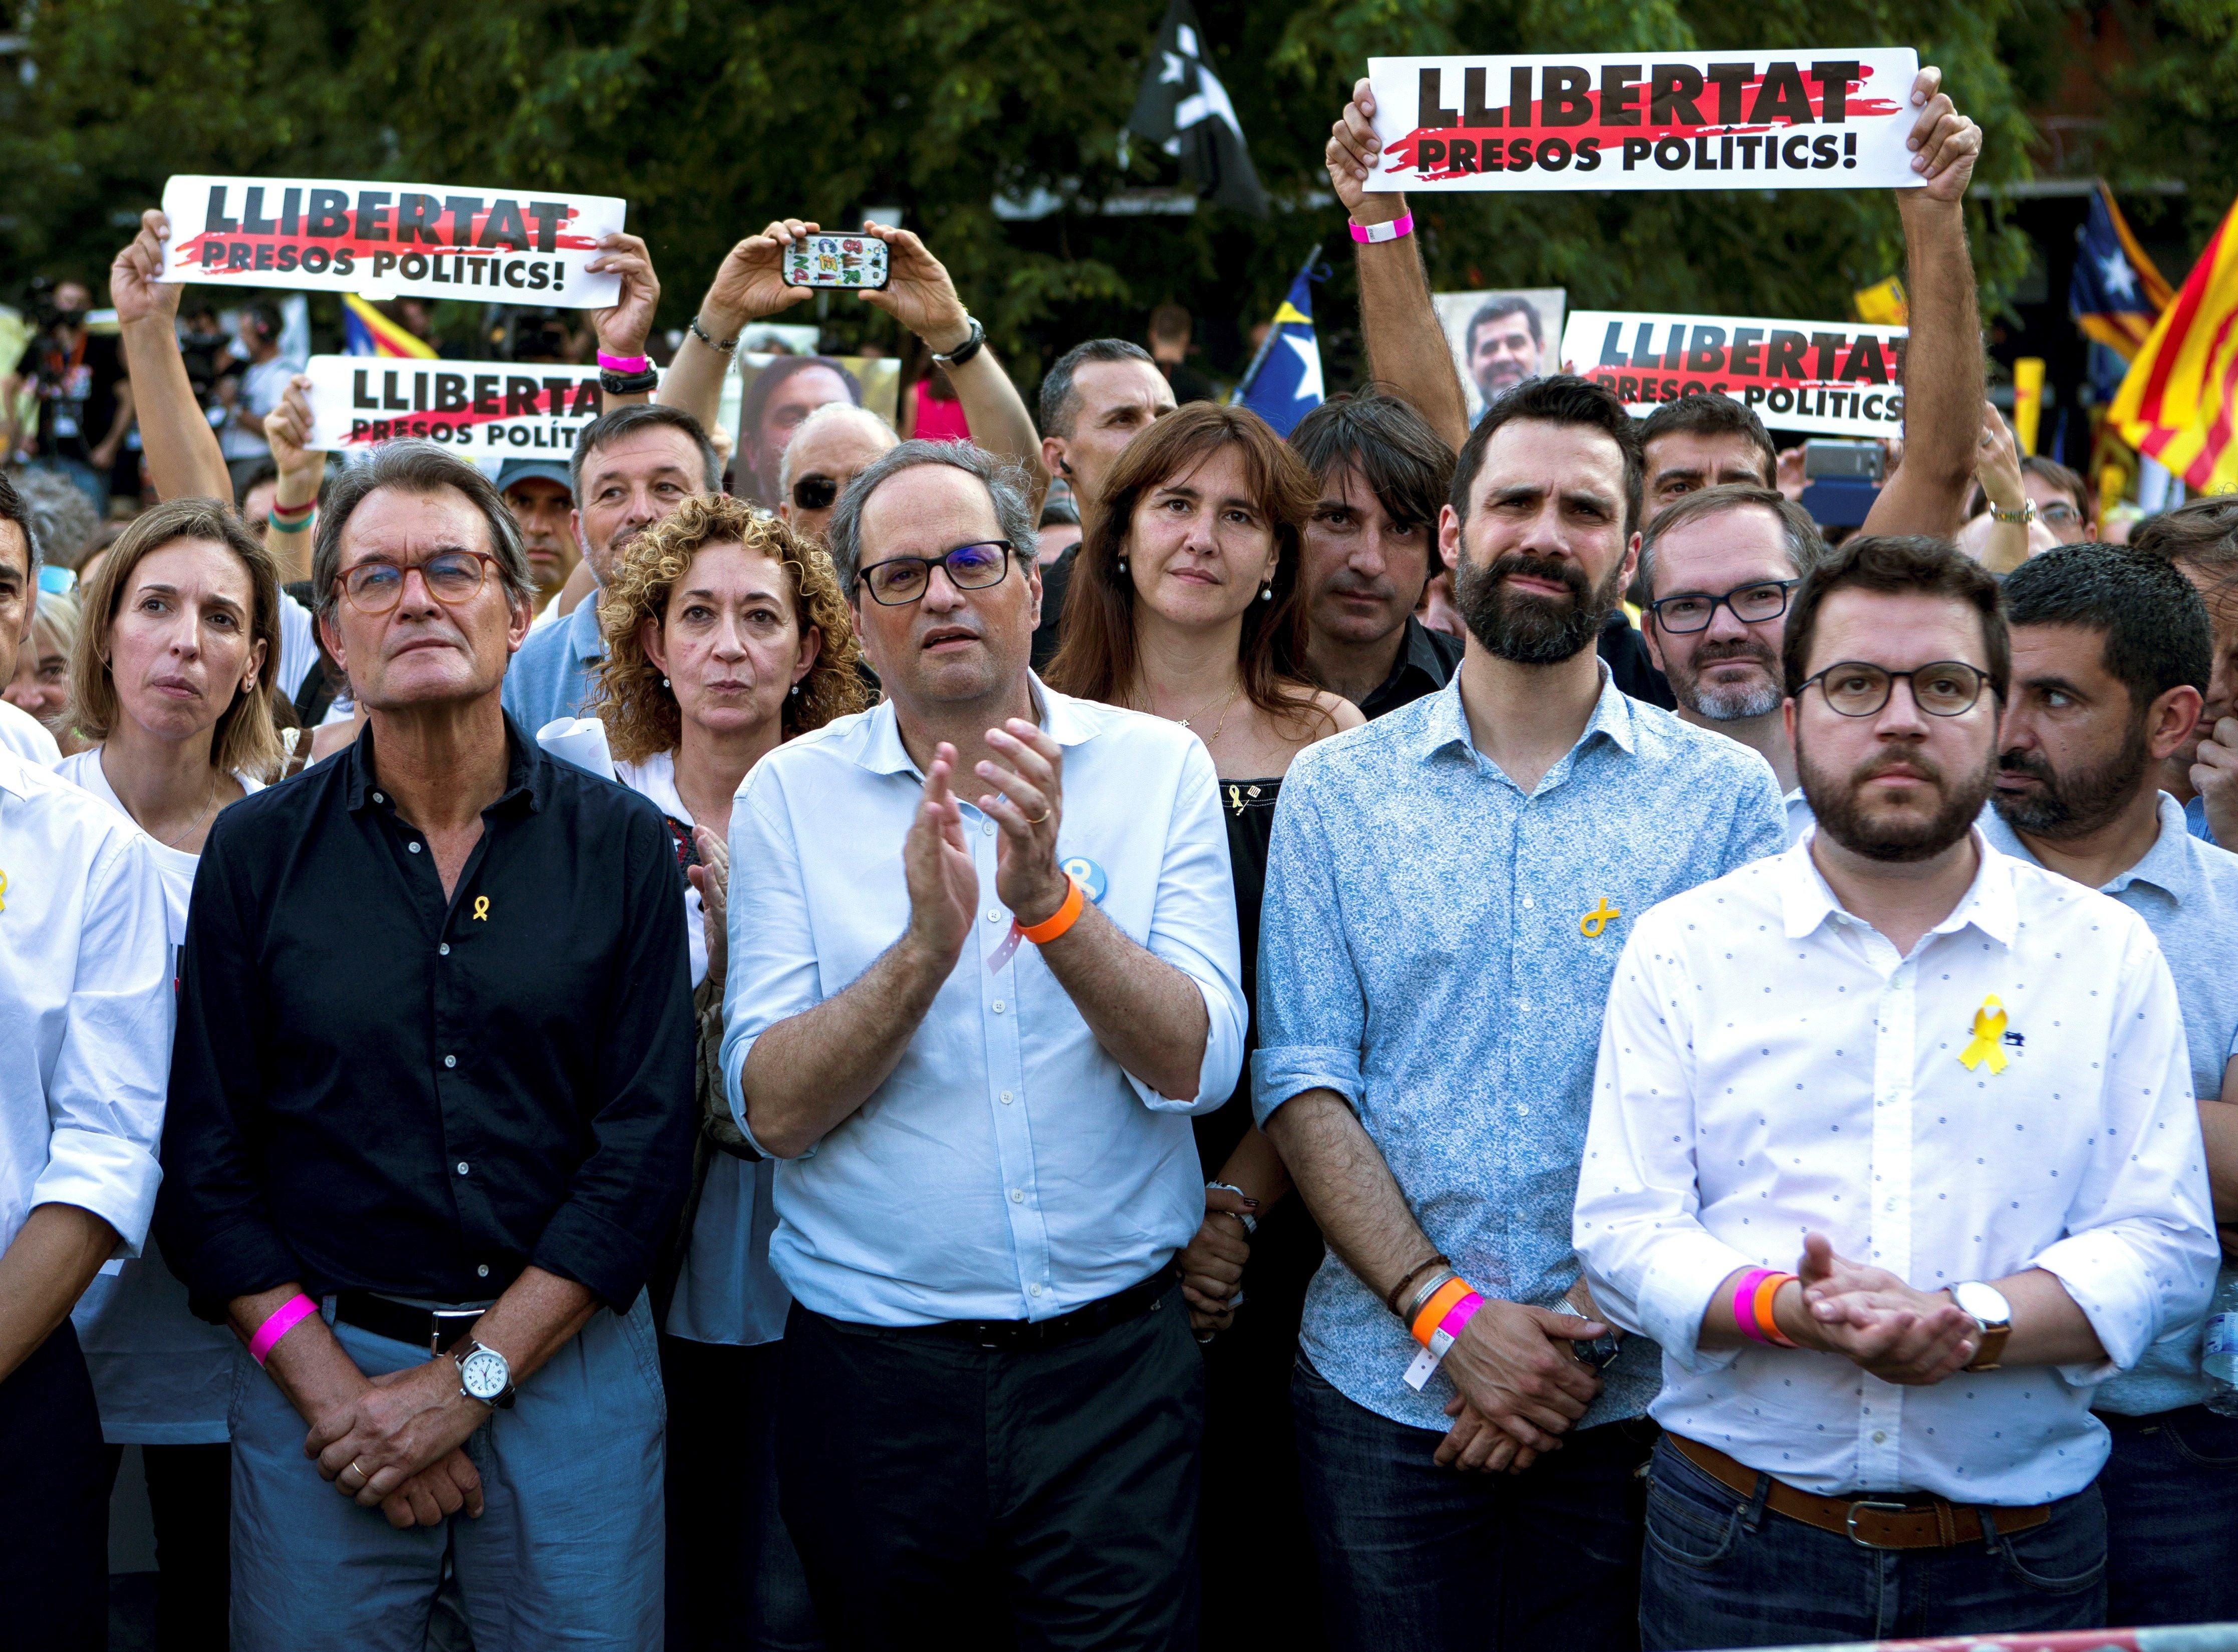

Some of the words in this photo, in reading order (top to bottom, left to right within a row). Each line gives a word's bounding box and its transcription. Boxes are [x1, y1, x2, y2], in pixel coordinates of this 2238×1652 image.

[1418, 60, 1860, 129] LLIBERTAT
[1417, 136, 1602, 173] PRESOS
[1622, 125, 1857, 171] POLÍTICS!
[204, 185, 569, 254] LLIBERTAT
[201, 241, 354, 276] PRESOS
[372, 247, 565, 292] POLÍTICS!
[353, 369, 603, 417] LLIBERTA
[1744, 378, 1905, 422] POLÍTICS
[351, 418, 473, 445] PRESOS
[487, 420, 581, 448] POLÍT
